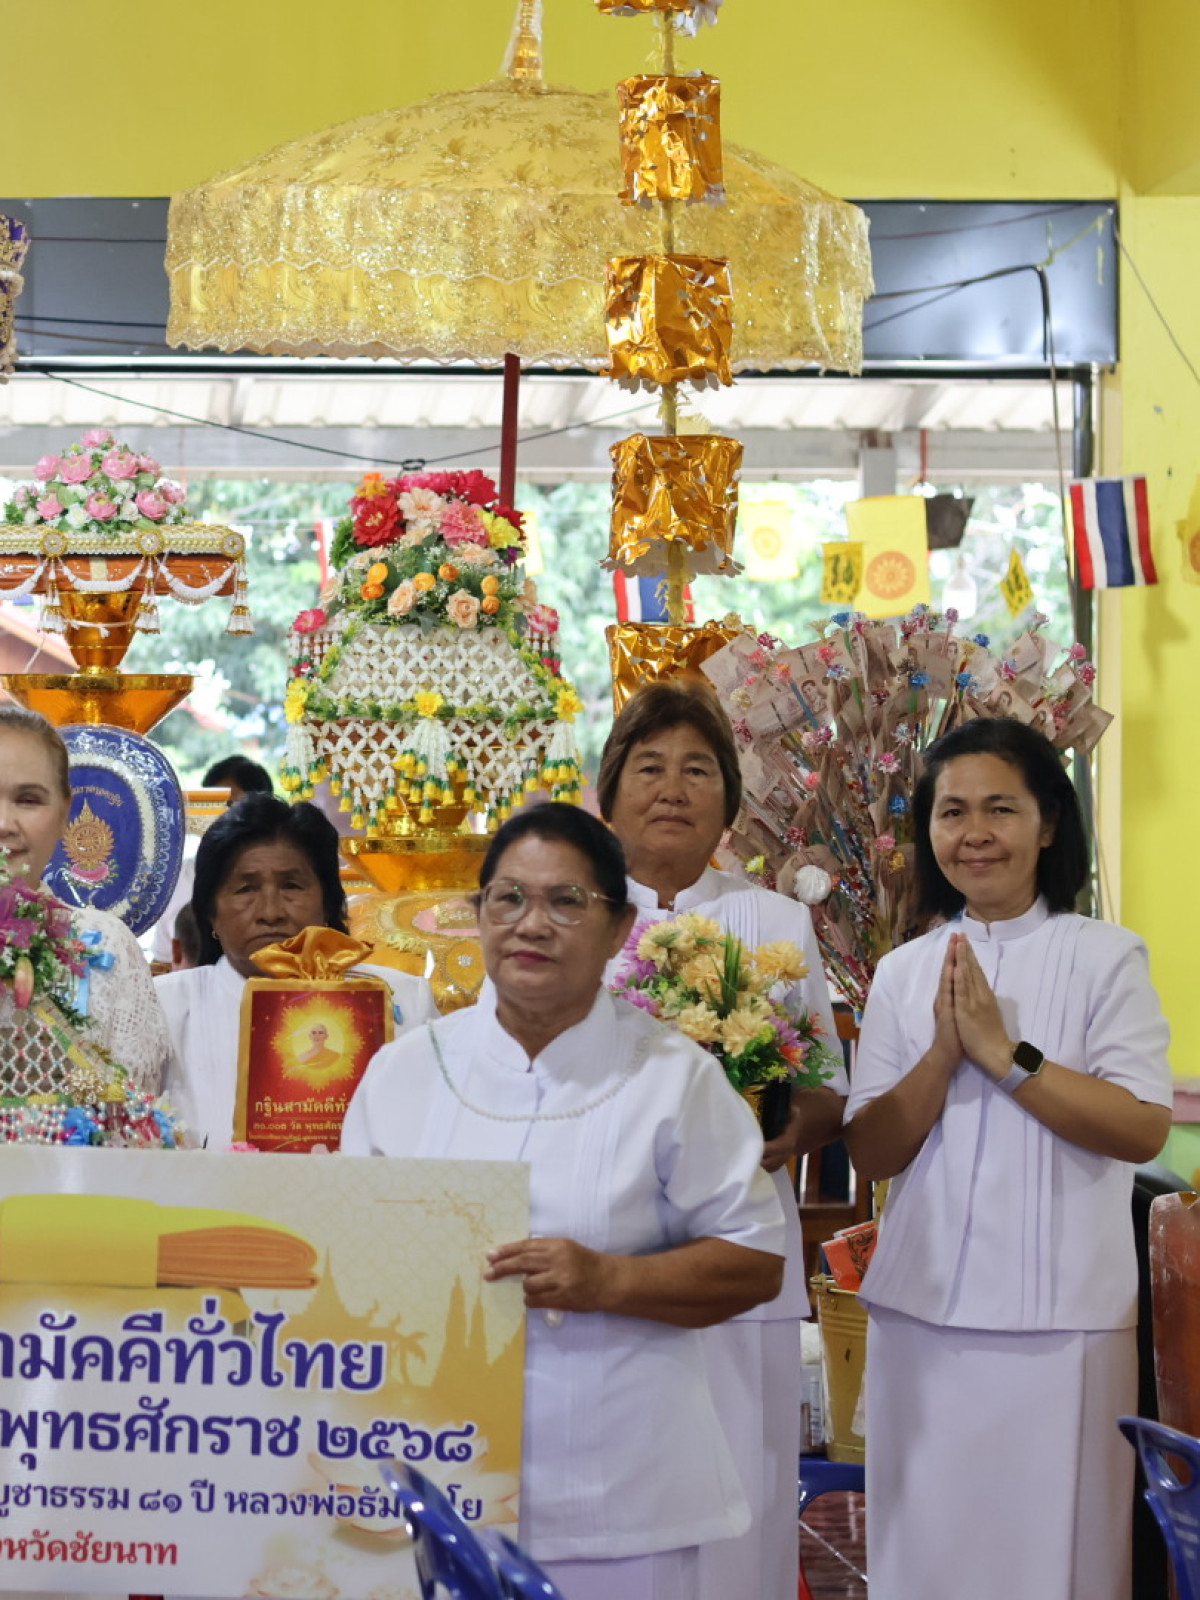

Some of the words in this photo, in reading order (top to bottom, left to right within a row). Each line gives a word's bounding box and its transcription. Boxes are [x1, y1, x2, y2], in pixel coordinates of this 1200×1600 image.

[316, 1419, 475, 1462] ๒๕๖๘
[138, 1489, 183, 1514] ๘๑
[189, 1479, 216, 1514] ปี
[224, 1484, 483, 1521] หลวงพ่อธัมโย
